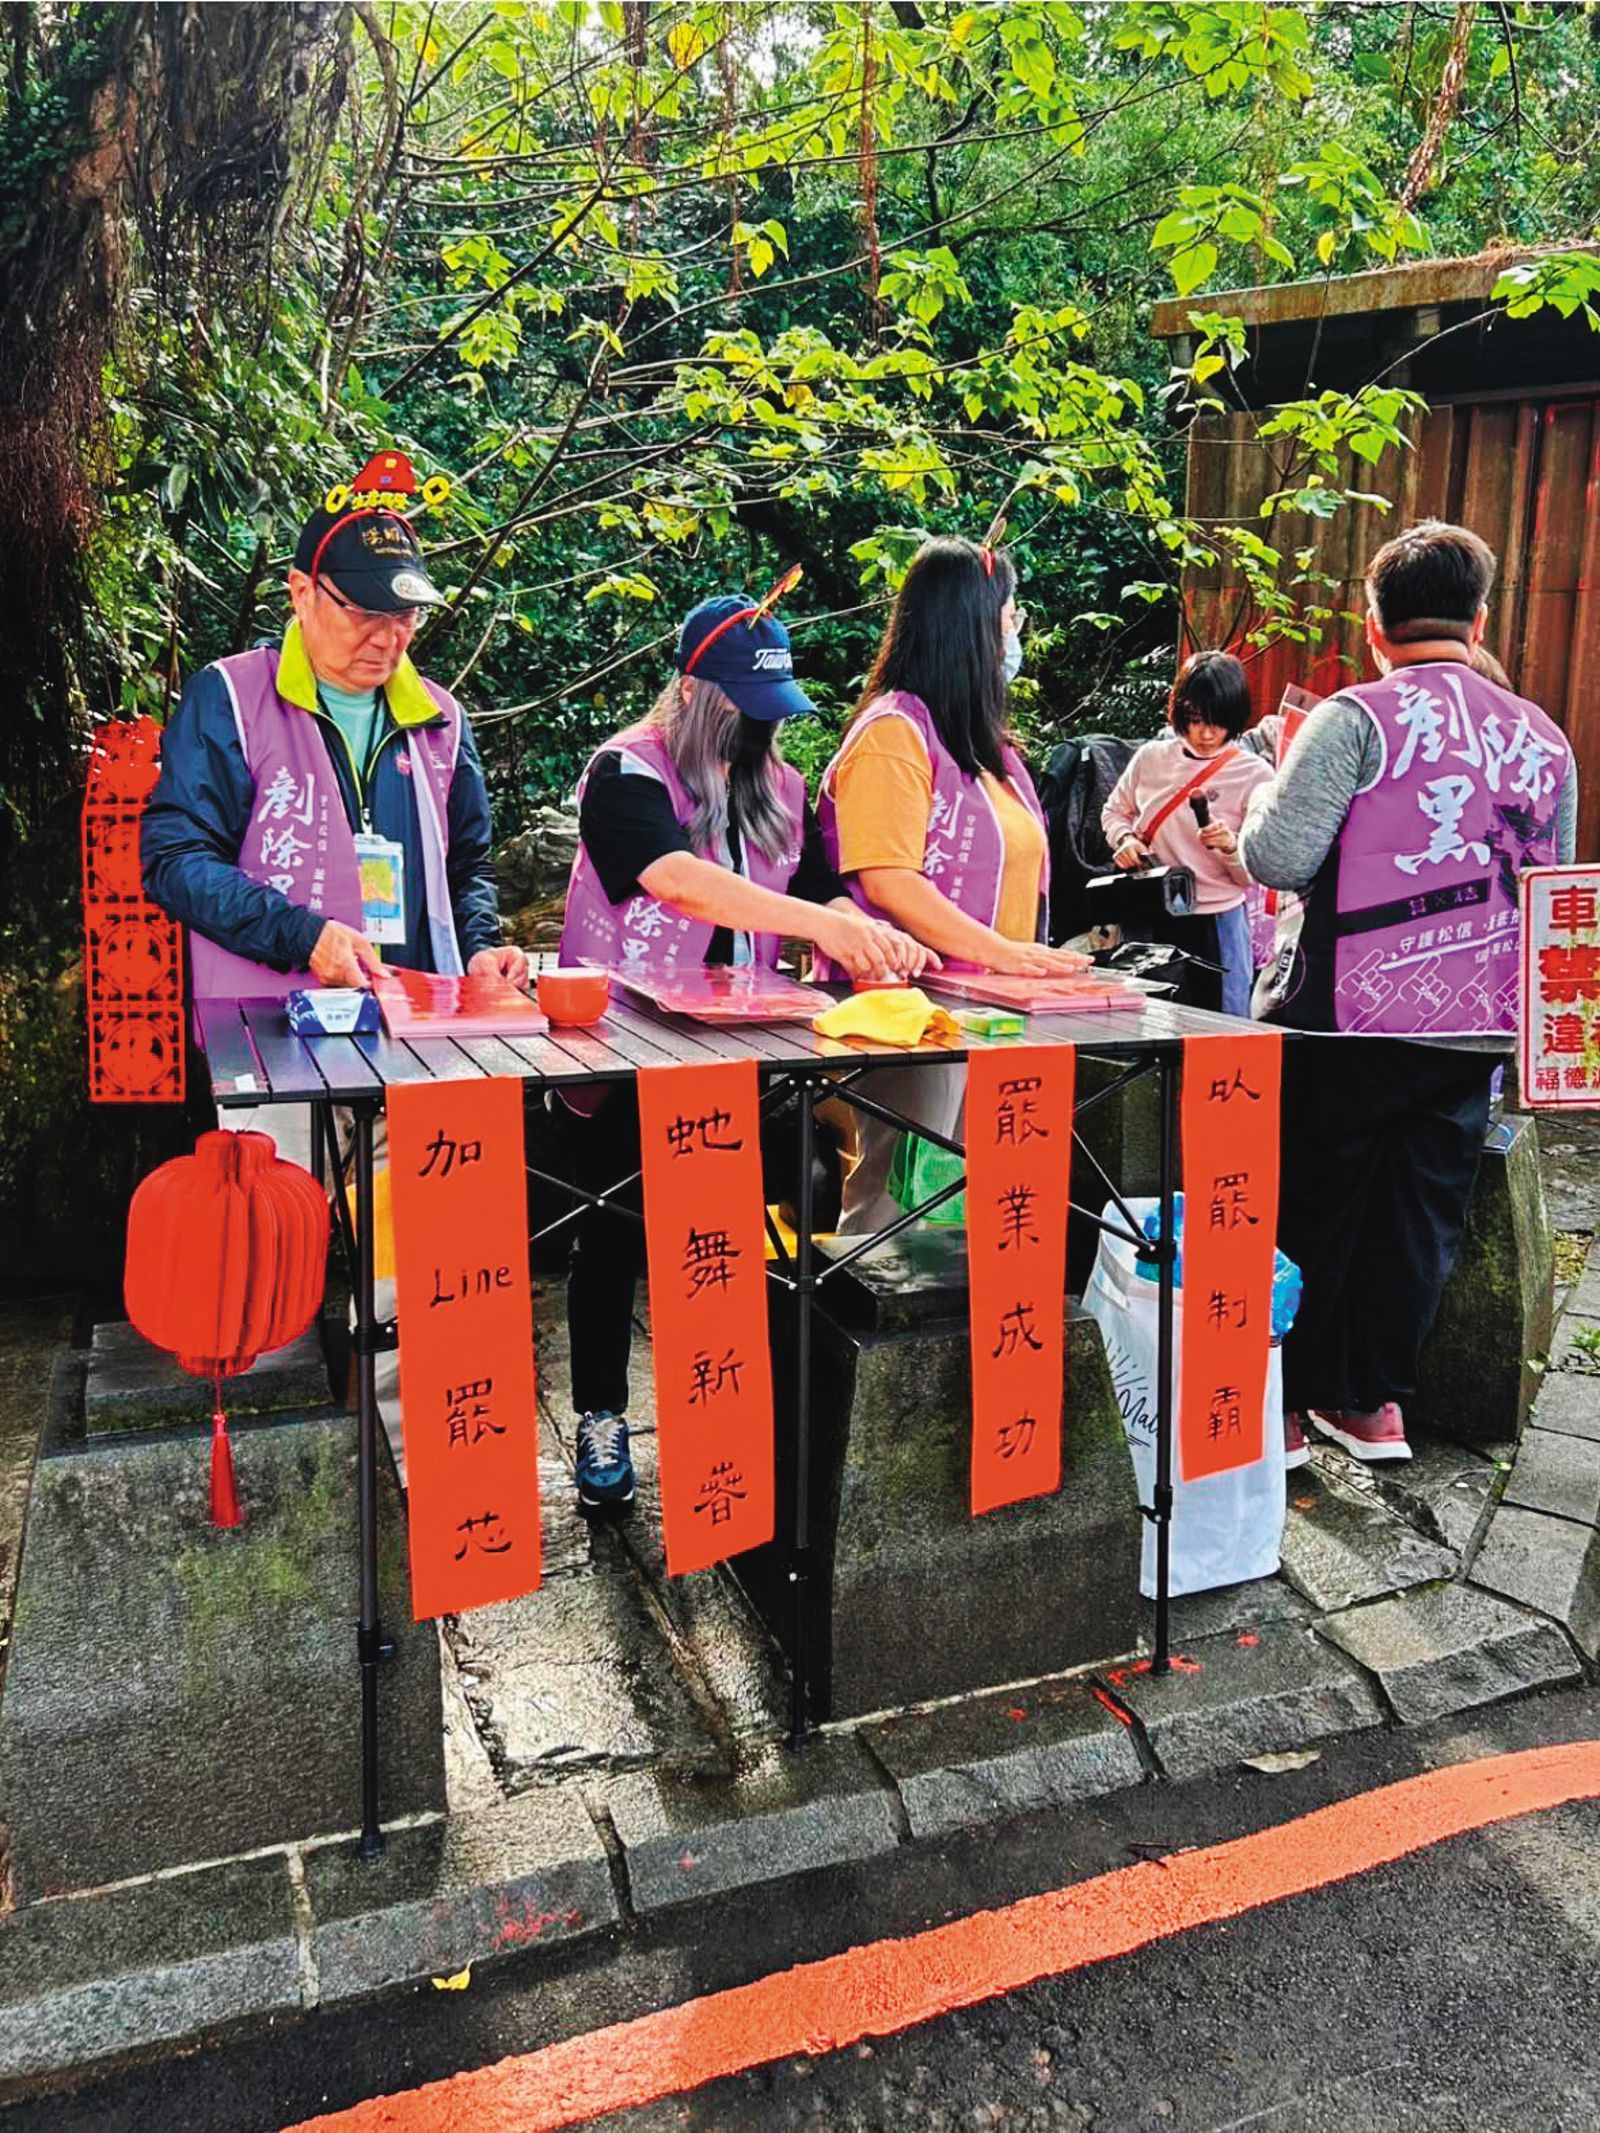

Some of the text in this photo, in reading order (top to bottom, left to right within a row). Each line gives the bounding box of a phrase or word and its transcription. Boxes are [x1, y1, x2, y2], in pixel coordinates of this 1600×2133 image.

[1395, 774, 1491, 875] 黑
[1549, 885, 1598, 935] 車
[1543, 1012, 1600, 1055] 違
